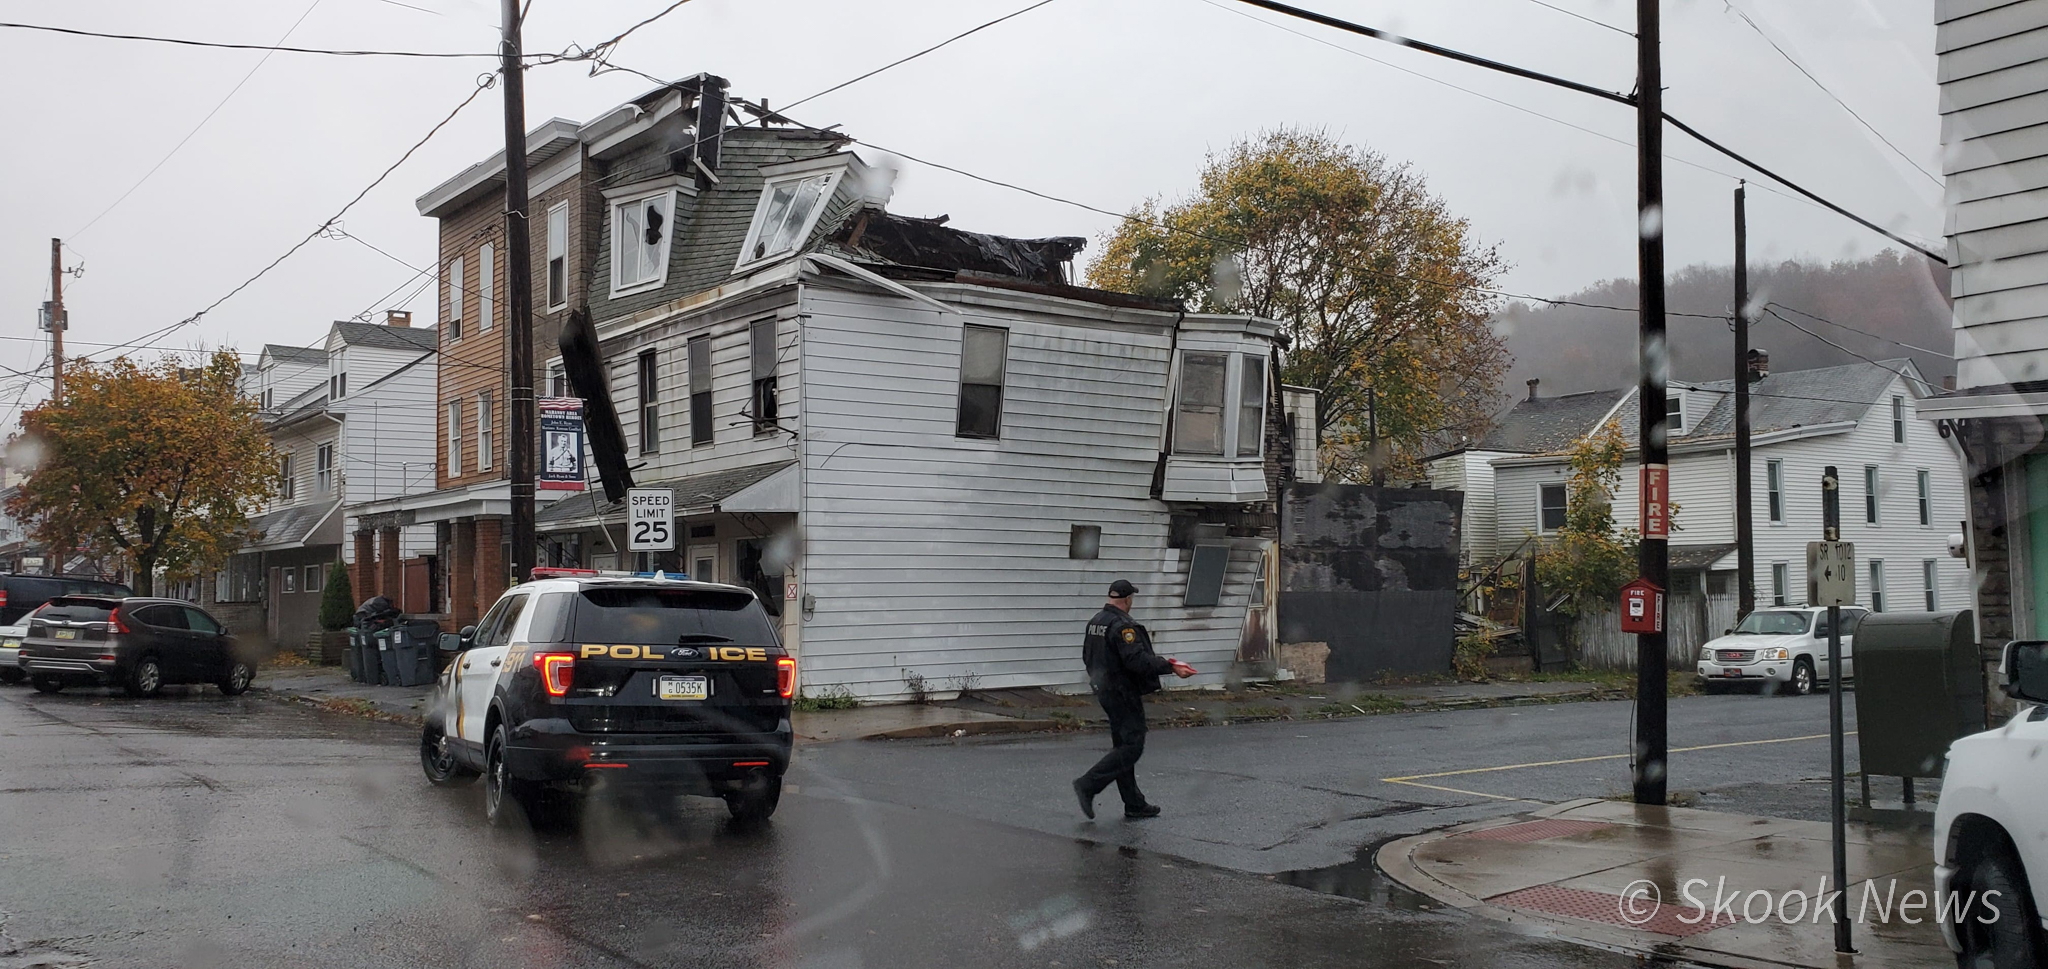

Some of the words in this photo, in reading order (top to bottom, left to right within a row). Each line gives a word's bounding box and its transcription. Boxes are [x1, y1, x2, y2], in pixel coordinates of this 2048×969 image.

[632, 496, 670, 506] SPEED
[1648, 471, 1662, 532] FIRE
[636, 508, 666, 518] LIMIT
[634, 521, 669, 543] 25
[1820, 543, 1829, 560] SR
[1837, 564, 1846, 581] 10
[1088, 624, 1108, 637] POLICE
[502, 652, 526, 673] 911
[675, 681, 703, 694] 0535K
